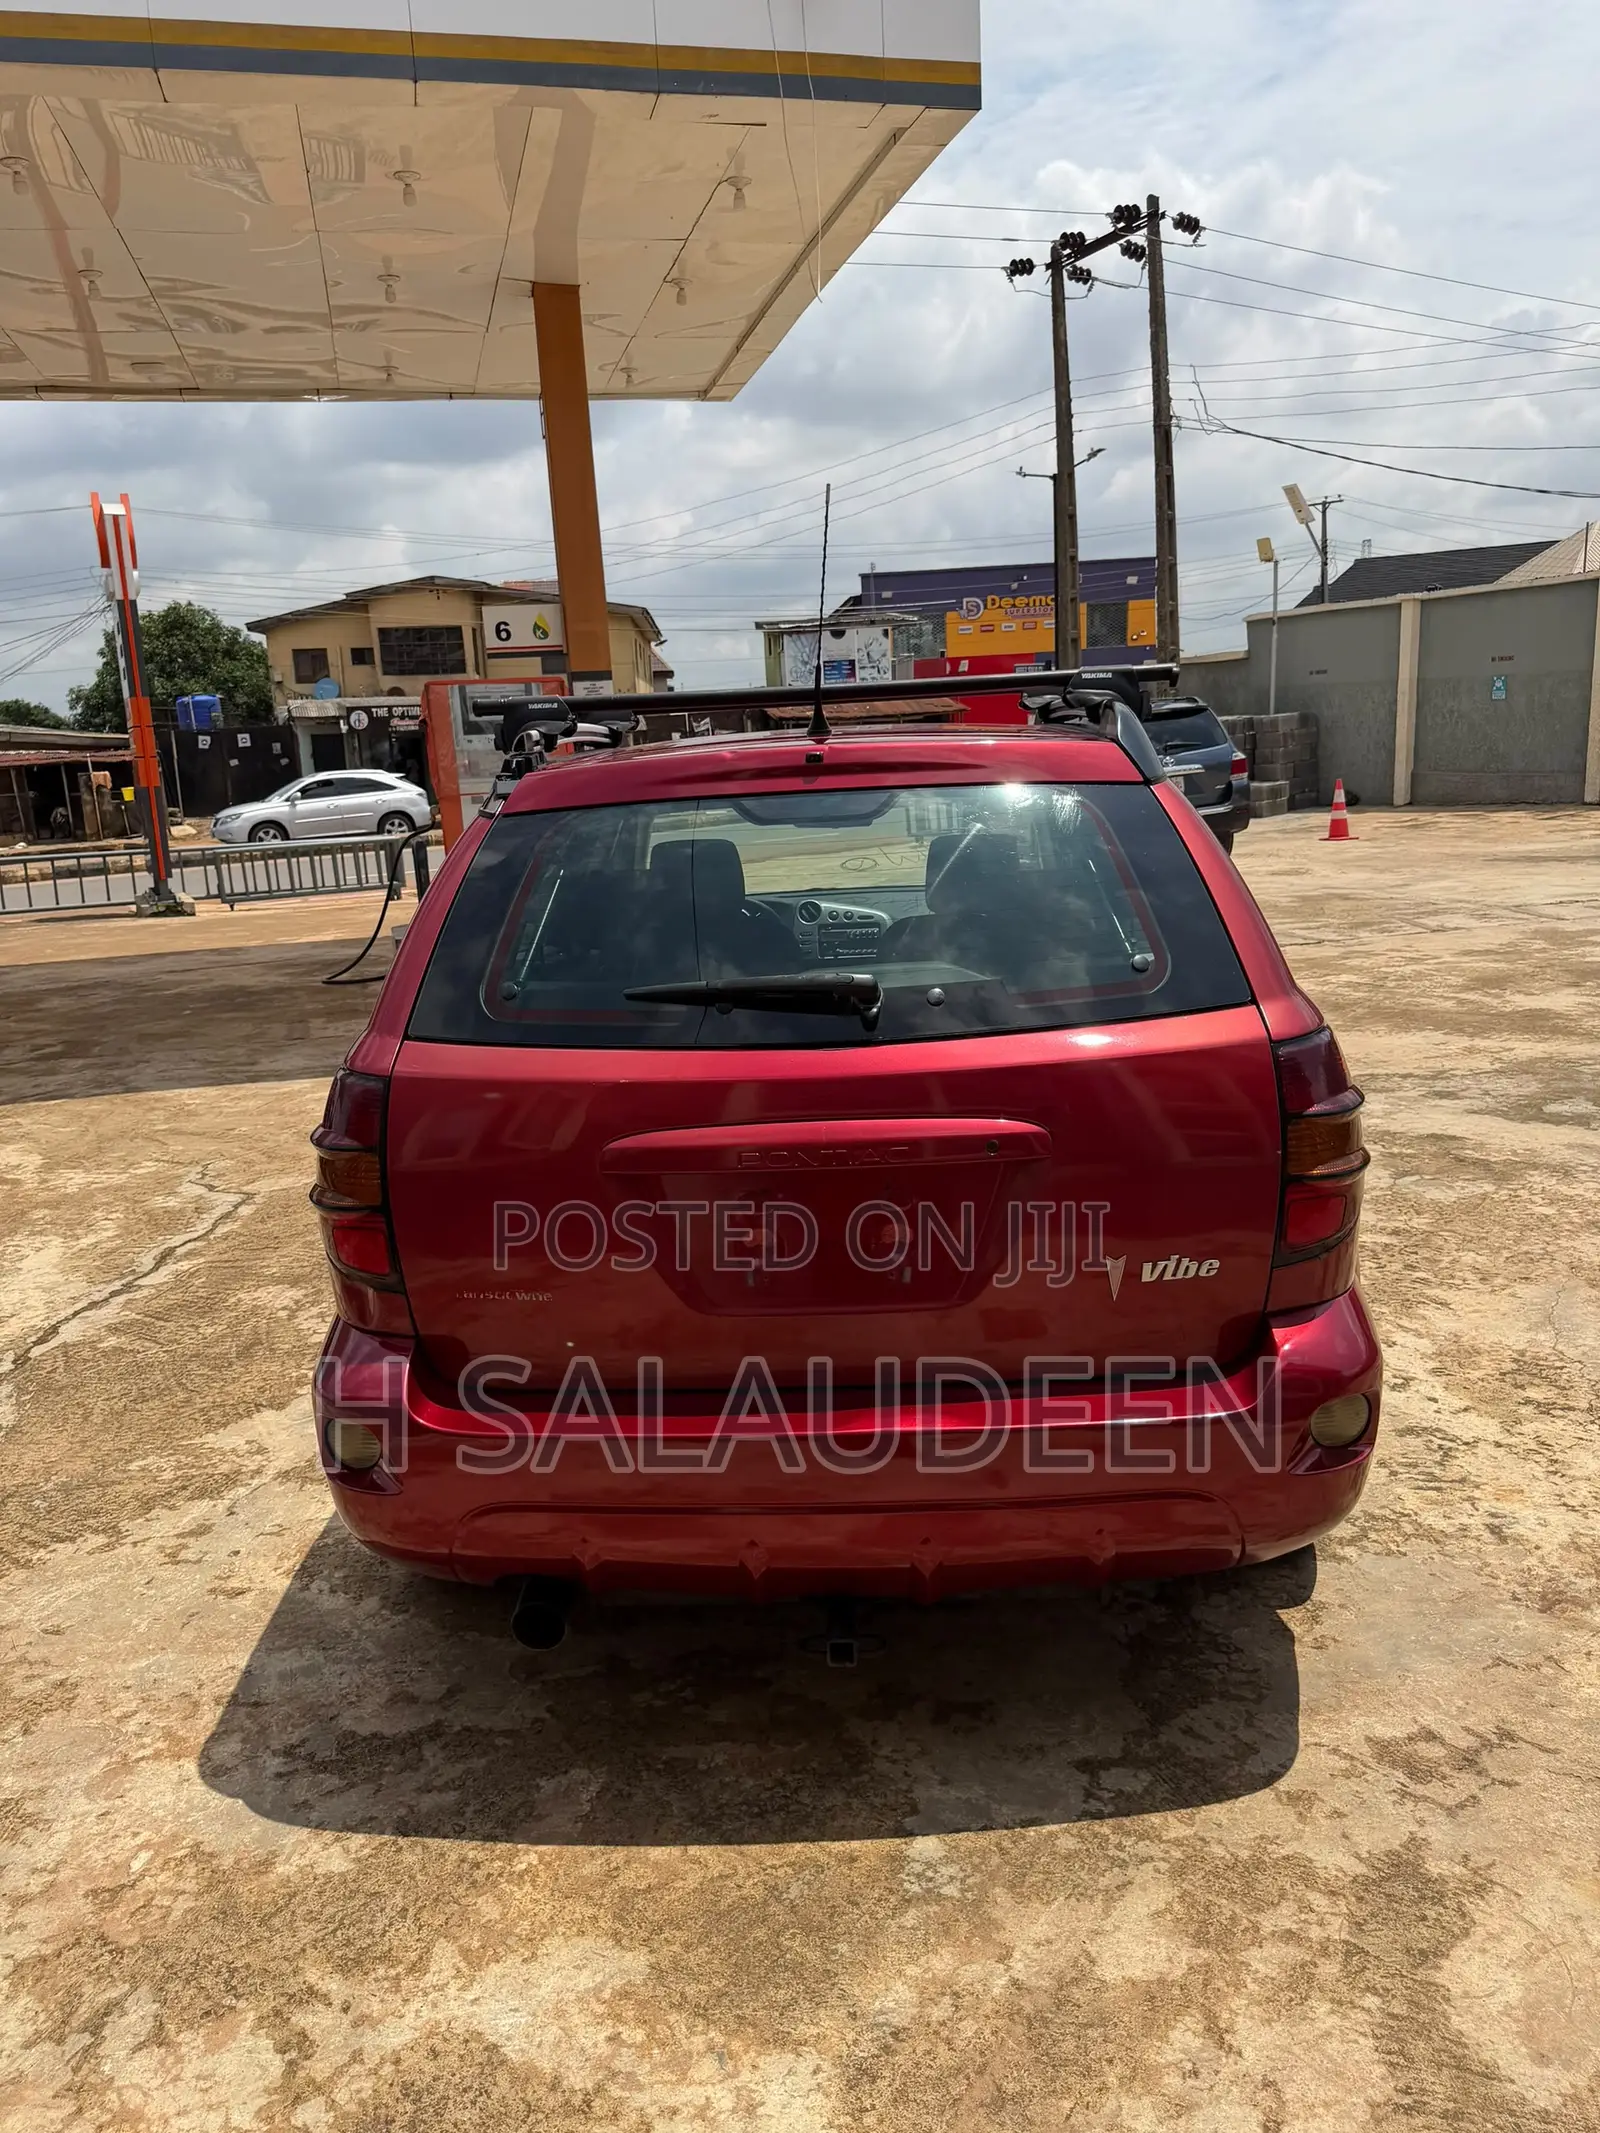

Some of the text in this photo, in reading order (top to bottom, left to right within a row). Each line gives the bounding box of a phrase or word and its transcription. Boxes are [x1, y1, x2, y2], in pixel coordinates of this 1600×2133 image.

[1004, 605, 1055, 616] SUPERSTOR
[495, 621, 512, 642] 6
[1081, 671, 1113, 679] YAKIMA
[371, 707, 389, 718] THE
[1141, 1254, 1220, 1283] vibe
